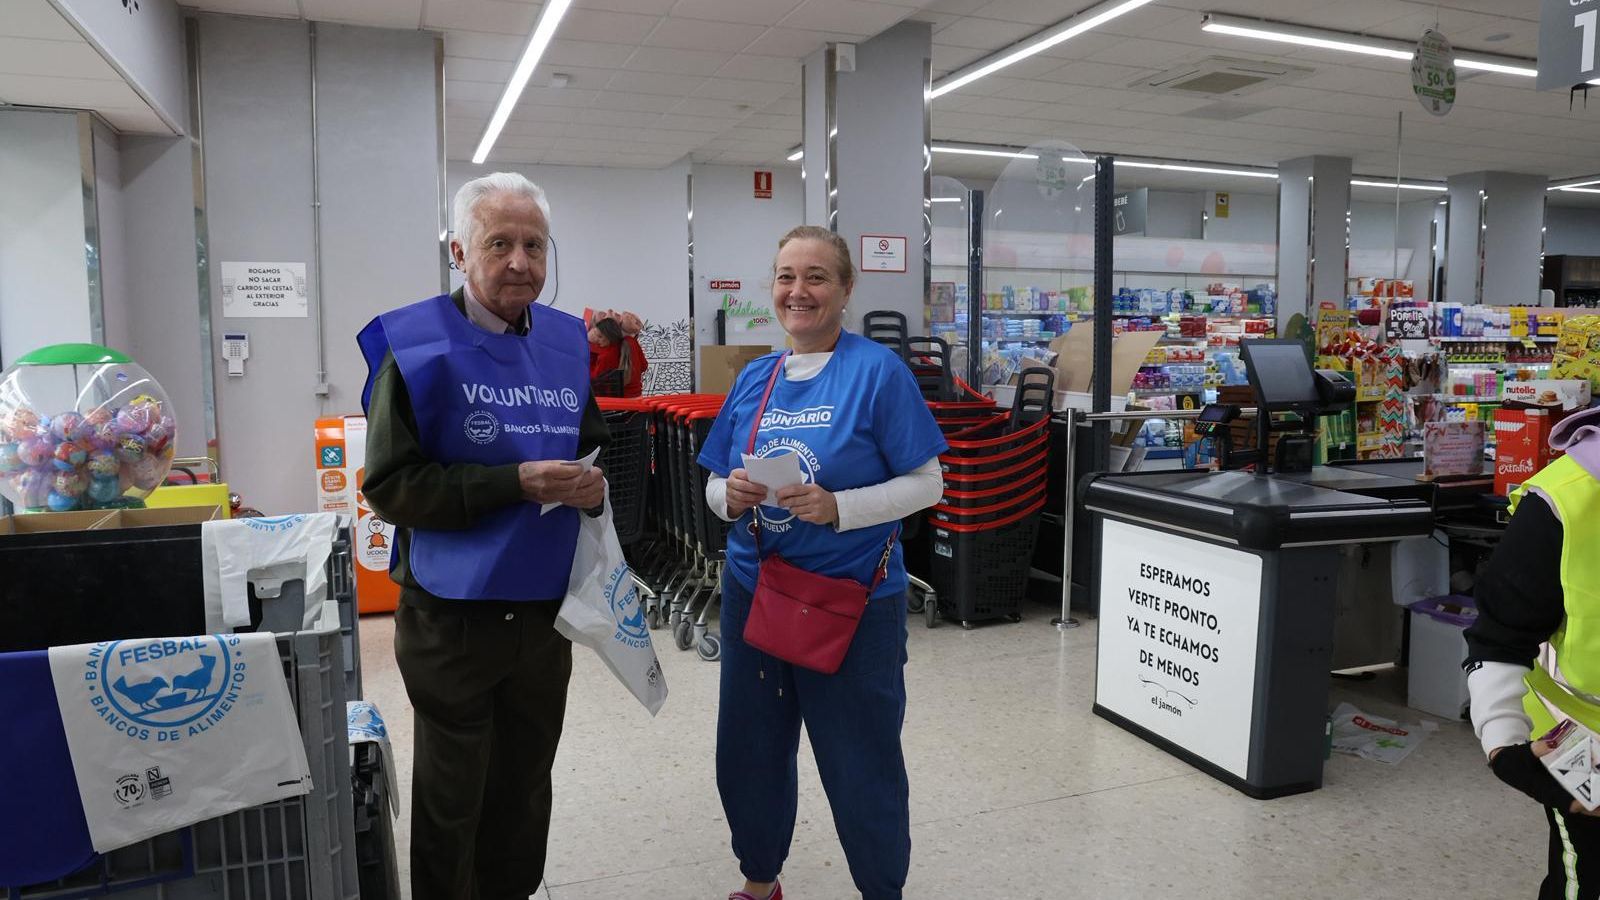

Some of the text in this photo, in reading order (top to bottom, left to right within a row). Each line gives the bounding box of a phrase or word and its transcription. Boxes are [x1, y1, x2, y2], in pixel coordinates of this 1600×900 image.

[1574, 9, 1597, 73] 1
[719, 281, 740, 289] jamón
[462, 383, 580, 413] VOLUNTARI@
[1506, 386, 1536, 395] nutella
[504, 423, 580, 436] BANCOS DE ALIMENTO
[768, 438, 780, 448] DE
[780, 437, 821, 472] ALIMENTOS
[762, 520, 793, 533] HUELVA
[610, 566, 620, 581] DE
[1140, 563, 1210, 597] ESPERAMOS
[1128, 587, 1221, 635] VERTE PRONTO,
[119, 637, 207, 667] FESBAL
[614, 631, 649, 649] BANCOS
[1127, 615, 1219, 663] YA TE ECHAMOS
[1140, 649, 1200, 687] DE MENOS
[90, 662, 246, 742] BANCOS DE ALIMENTOS
[1151, 696, 1182, 717] el jamón
